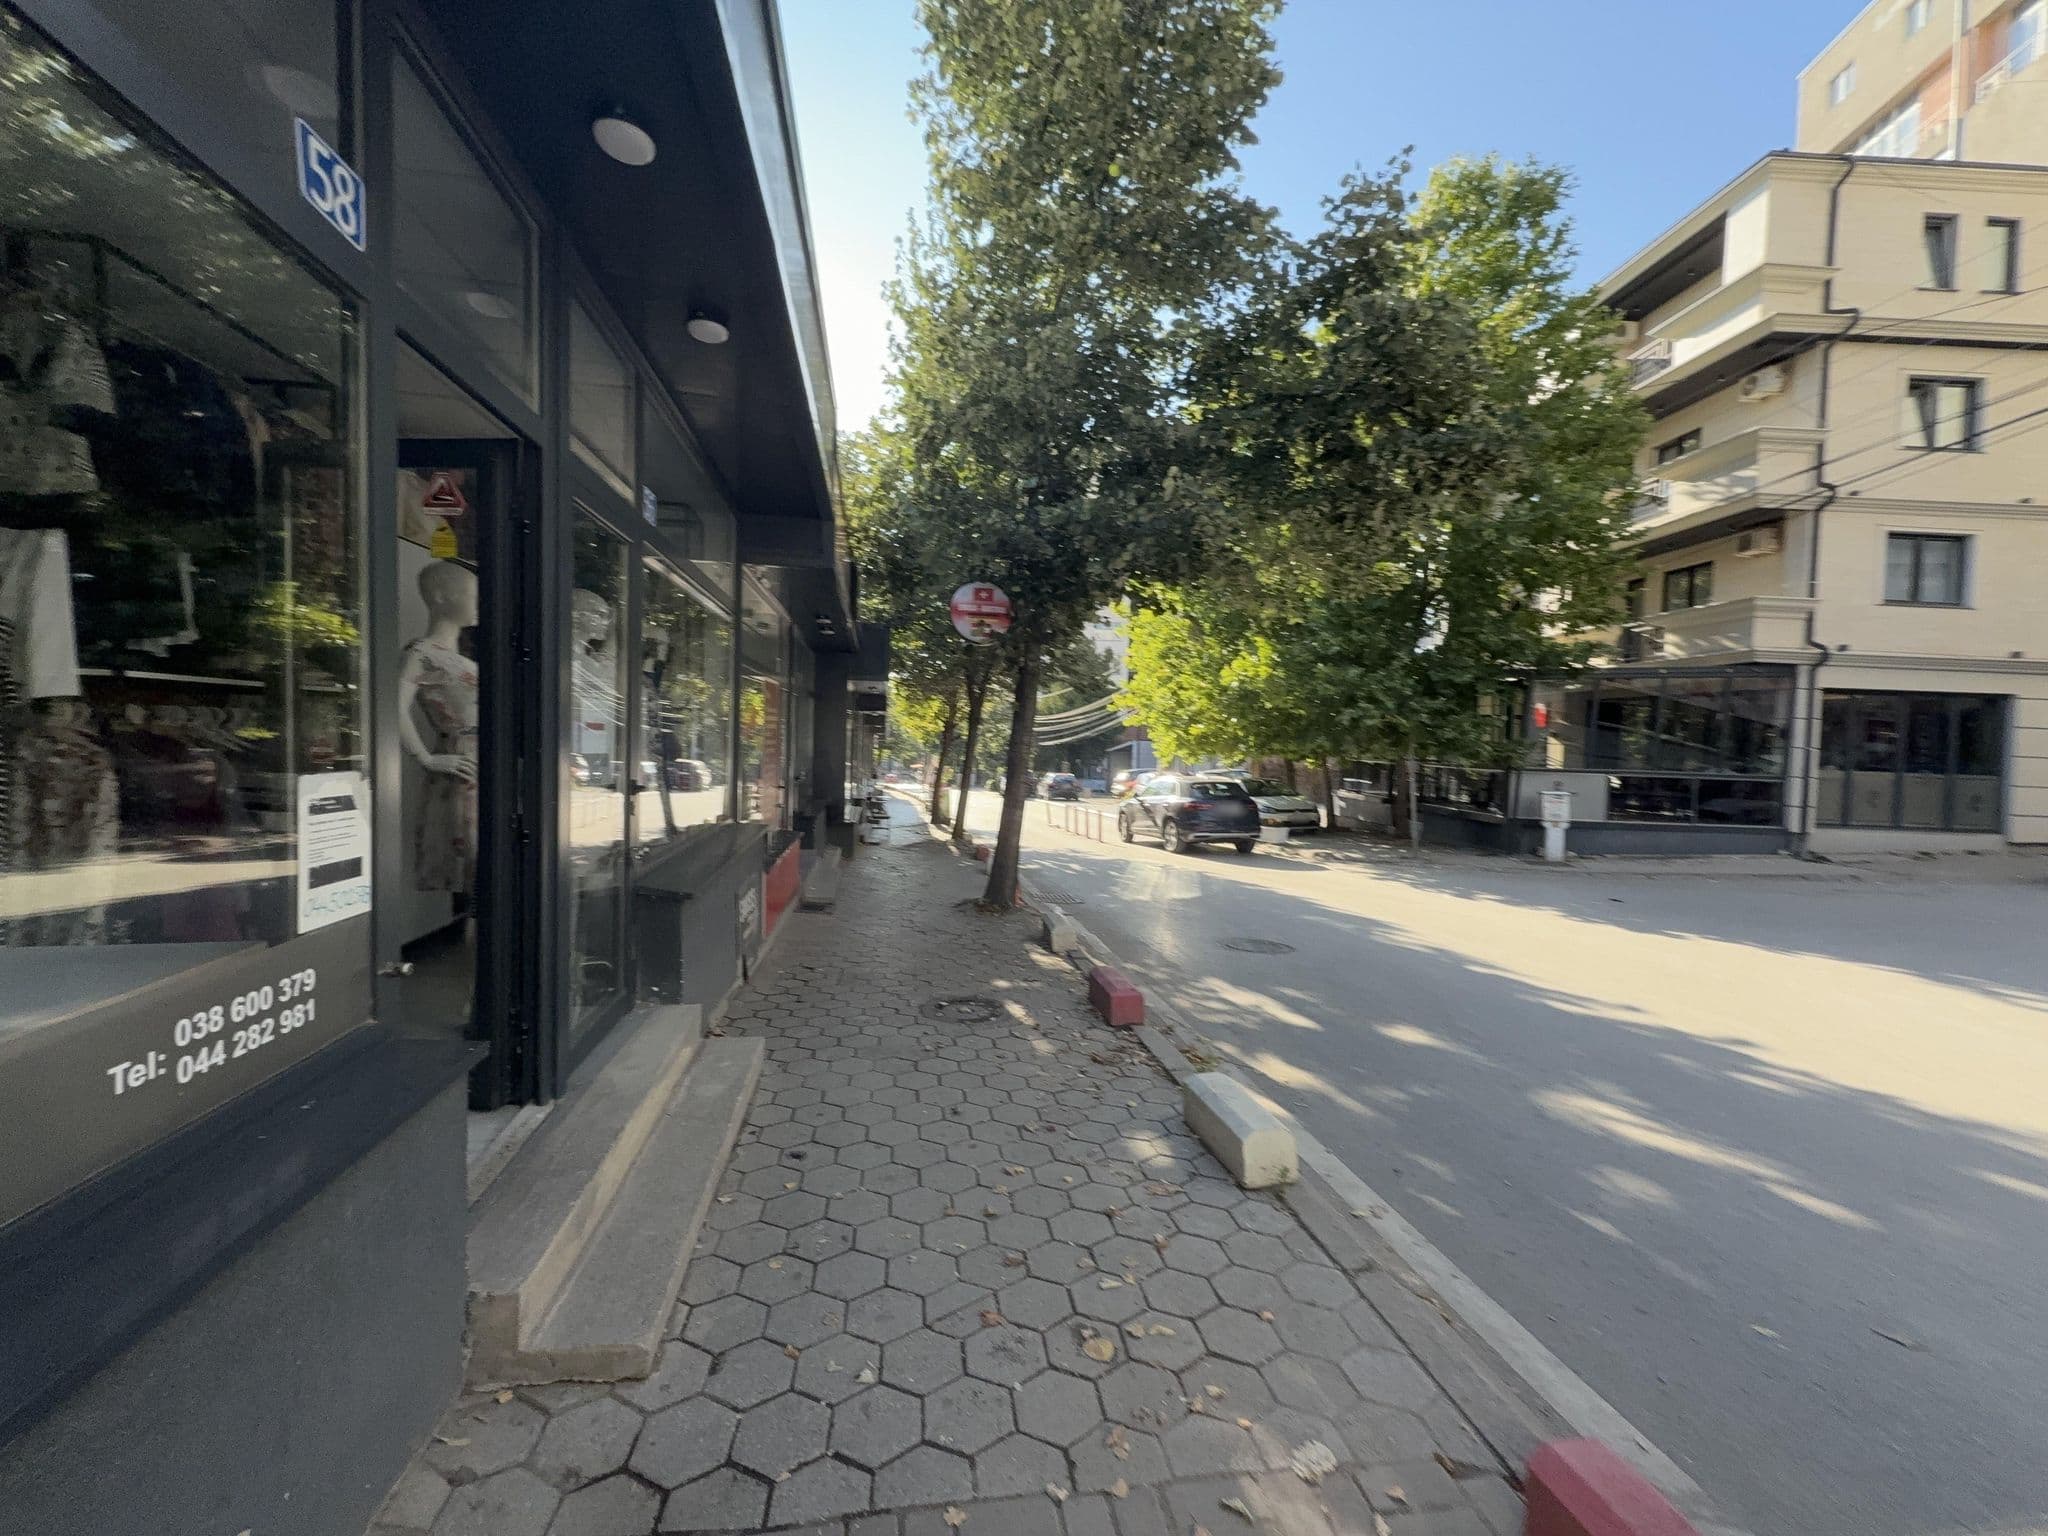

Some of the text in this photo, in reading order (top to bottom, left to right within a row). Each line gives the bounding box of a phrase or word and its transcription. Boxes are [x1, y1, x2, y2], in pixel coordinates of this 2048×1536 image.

[307, 134, 356, 236] 58
[174, 968, 316, 1047] 038 600 379
[176, 998, 316, 1084] 044 282 981
[106, 1051, 167, 1095] Tel:
